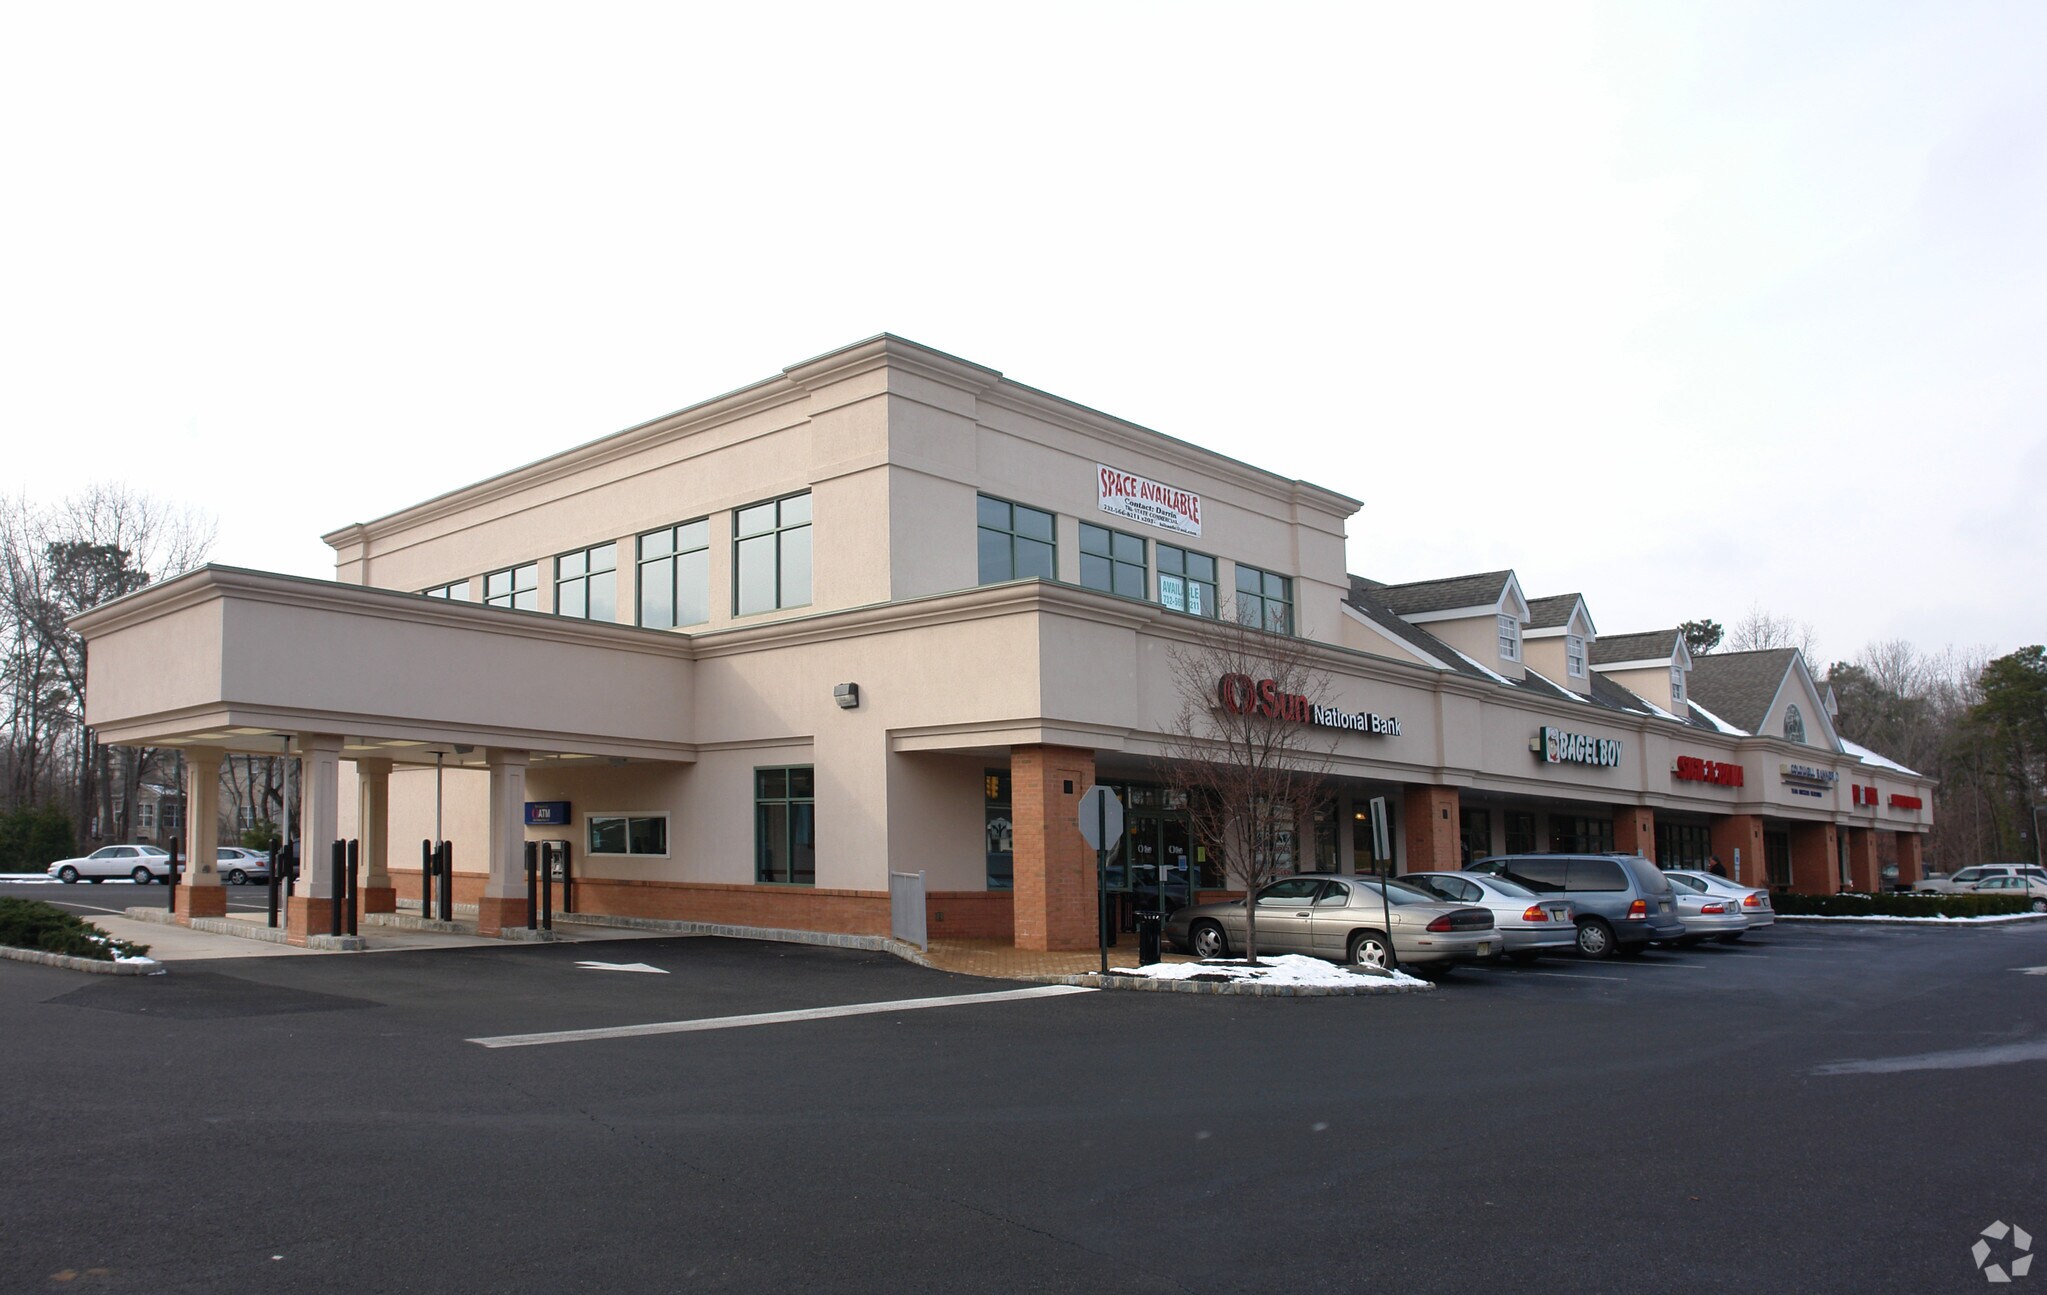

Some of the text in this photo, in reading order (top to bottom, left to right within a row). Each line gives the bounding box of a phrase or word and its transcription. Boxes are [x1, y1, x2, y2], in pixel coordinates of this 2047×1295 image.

[1101, 467, 1200, 525] SPACE AVAILABLE
[1124, 497, 1177, 519] Contact: Darrin
[1162, 580, 1199, 599] AVAILLE
[1257, 678, 1402, 736] Sun National Bank
[1559, 731, 1624, 767] BAGEL BOY
[538, 808, 551, 818] ATM
